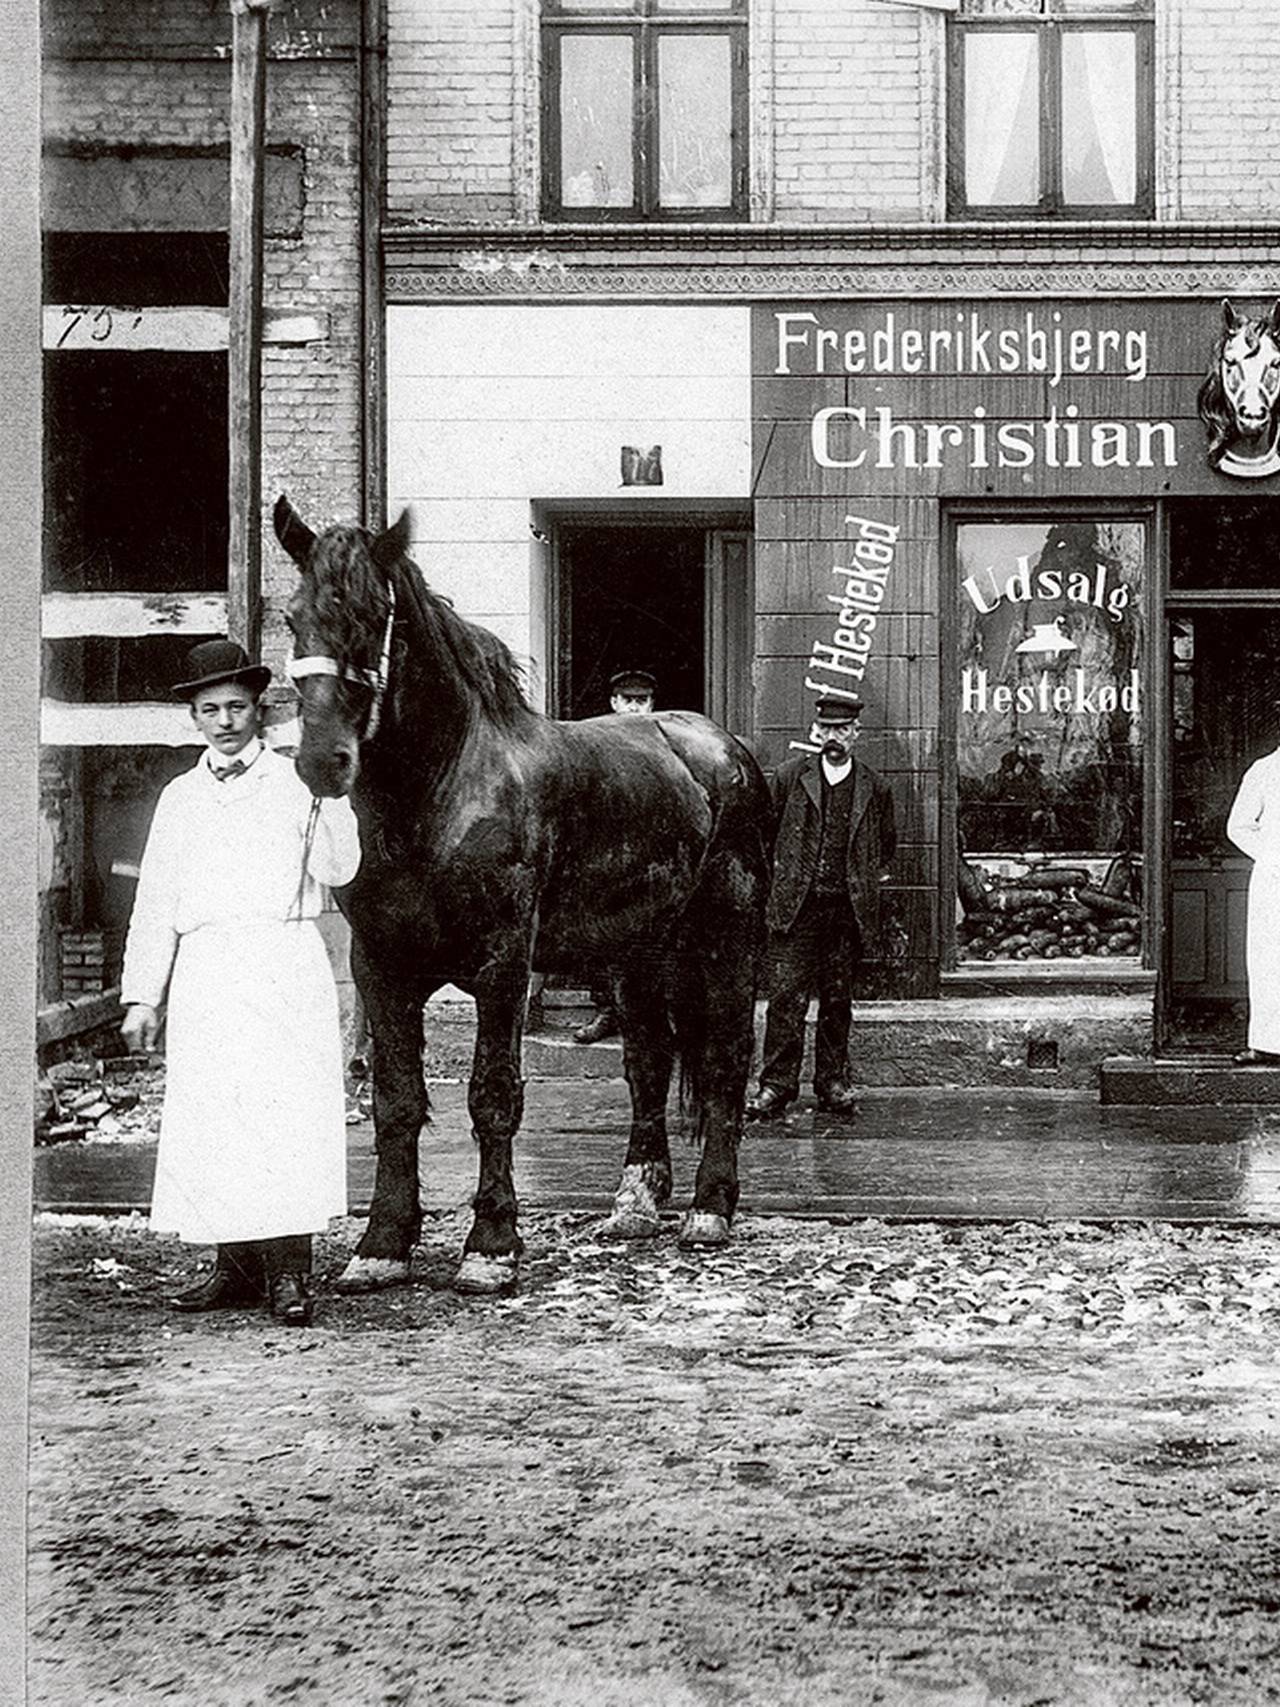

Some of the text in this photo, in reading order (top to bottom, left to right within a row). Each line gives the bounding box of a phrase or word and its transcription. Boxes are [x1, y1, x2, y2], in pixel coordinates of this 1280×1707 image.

[774, 312, 1149, 387] Frederiksbjerg
[810, 404, 1179, 469] Christian
[808, 515, 900, 681] Hestekød
[961, 555, 1130, 622] Udsalg
[961, 668, 1140, 715] Hestekød
